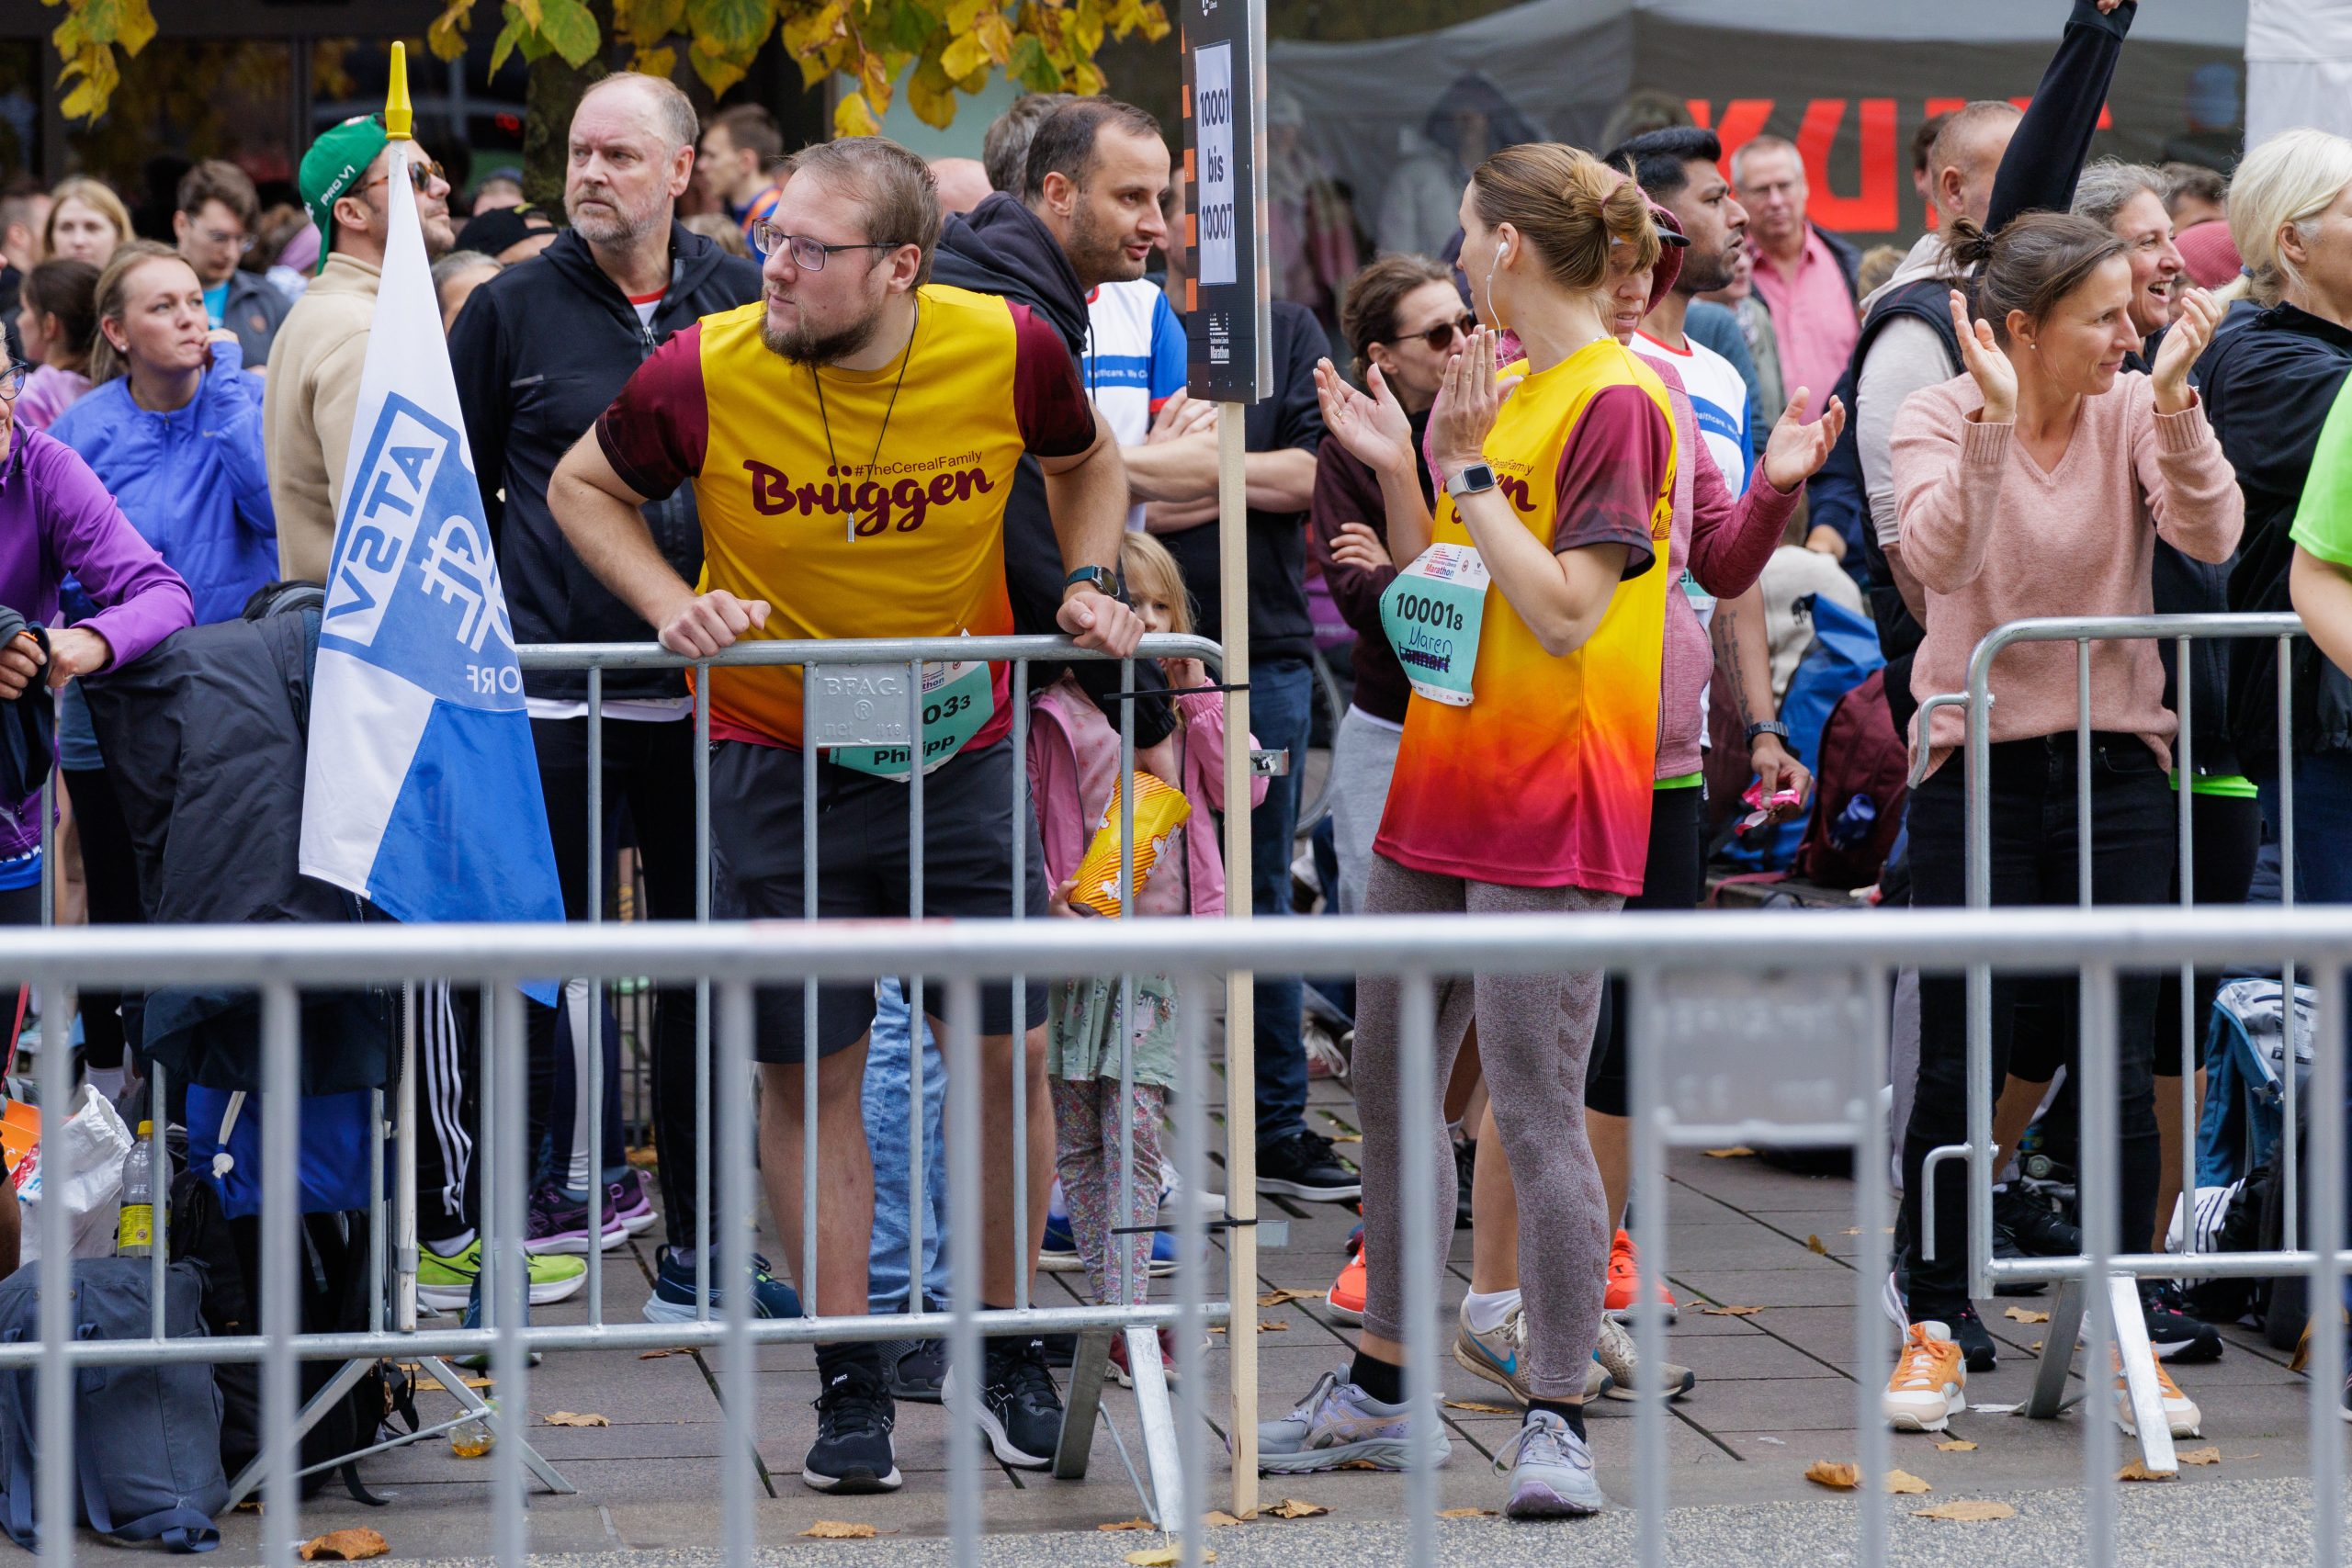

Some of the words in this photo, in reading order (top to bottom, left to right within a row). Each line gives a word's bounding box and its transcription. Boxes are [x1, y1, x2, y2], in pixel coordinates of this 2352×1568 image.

[1200, 88, 1229, 127] 10001
[1207, 145, 1224, 183] bis
[320, 178, 343, 207] PRO
[1201, 203, 1232, 241] 10007
[854, 450, 983, 478] #TheCerealFamily
[742, 458, 995, 537] Brüggen
[1424, 563, 1454, 578] Marathon
[1408, 626, 1453, 657] Maren
[922, 677, 944, 691] thon
[874, 735, 956, 765] Phiipp
